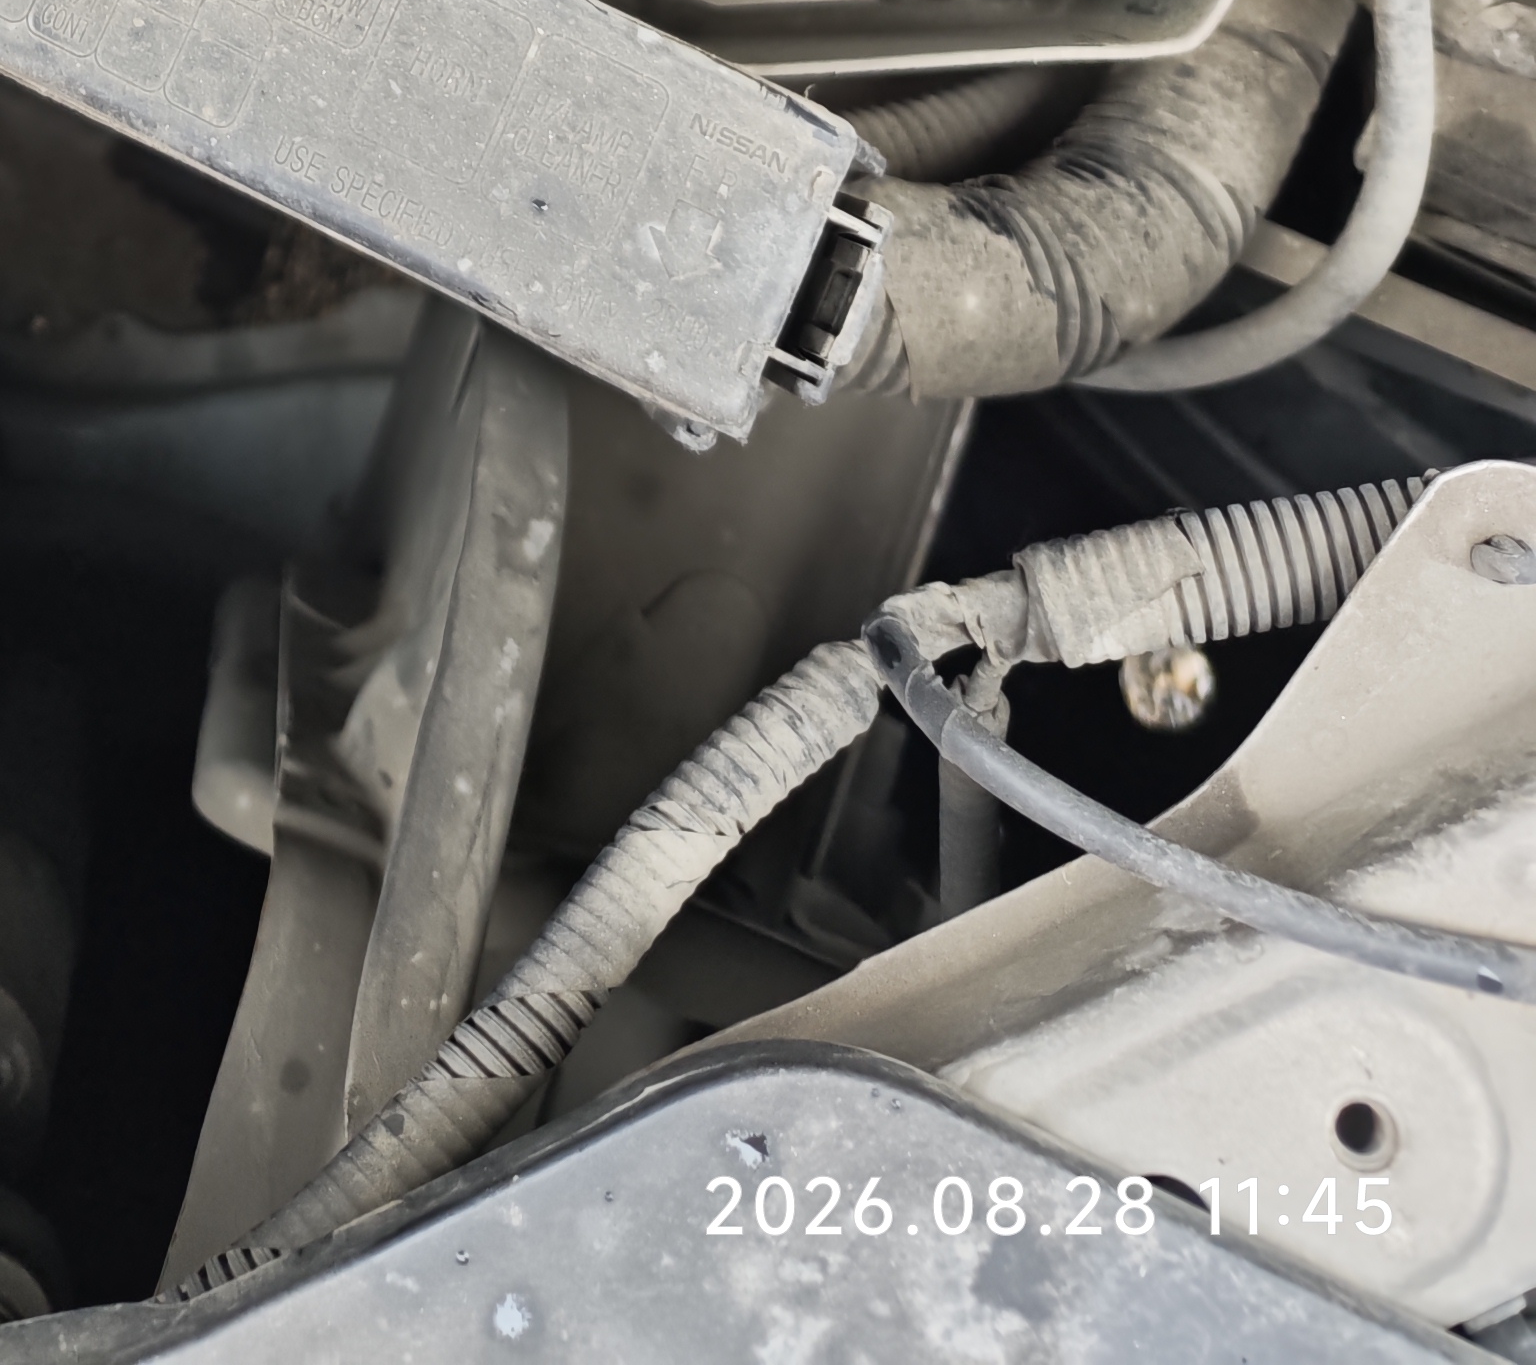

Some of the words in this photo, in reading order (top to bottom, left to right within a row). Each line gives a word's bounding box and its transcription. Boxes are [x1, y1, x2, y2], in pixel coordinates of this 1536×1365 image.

[37, 0, 92, 43] CONT
[686, 111, 790, 174] NISSAN
[270, 135, 326, 181] USE
[327, 164, 458, 248] SPECIFIED
